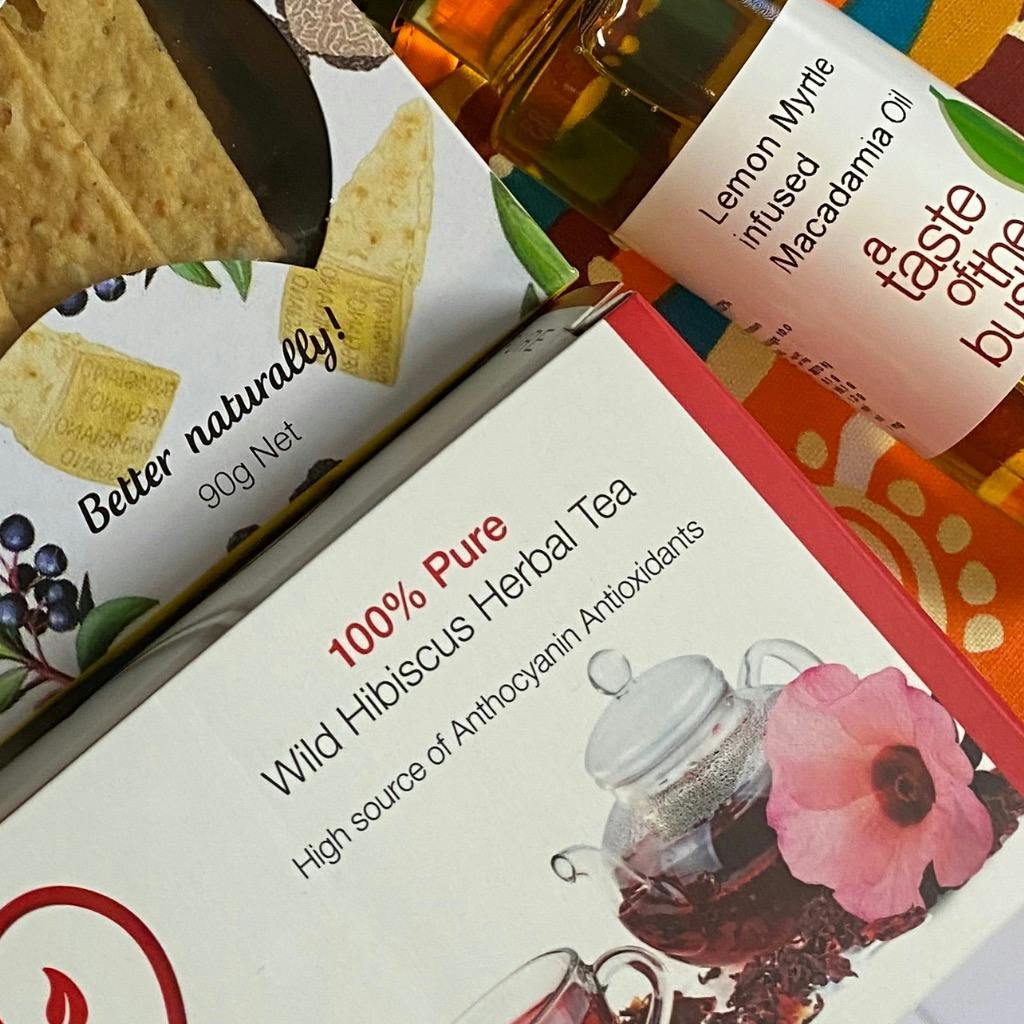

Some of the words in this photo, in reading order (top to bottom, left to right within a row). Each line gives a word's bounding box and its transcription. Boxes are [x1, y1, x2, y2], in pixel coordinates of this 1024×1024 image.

[698, 135, 782, 226] Lemon
[769, 57, 835, 134] Myrtle
[732, 151, 821, 250] infused
[769, 126, 894, 275] Macadamia
[880, 88, 914, 124] Oil
[863, 237, 897, 265] a
[875, 184, 986, 302] taste
[78, 448, 173, 535] Better
[183, 306, 346, 454] naturally!
[198, 462, 256, 509] 90g
[249, 420, 303, 468] Net
[259, 721, 343, 797] Wild
[336, 616, 475, 736] Hibiscus
[468, 520, 579, 621] Herbal
[567, 478, 637, 530] Tea
[328, 580, 428, 668] 100%
[422, 515, 508, 589] Pure
[291, 826, 352, 880] High
[350, 760, 427, 832] source
[426, 732, 453, 766] of
[450, 626, 582, 746] Anthocyanin
[578, 519, 705, 634] Antioxidants
